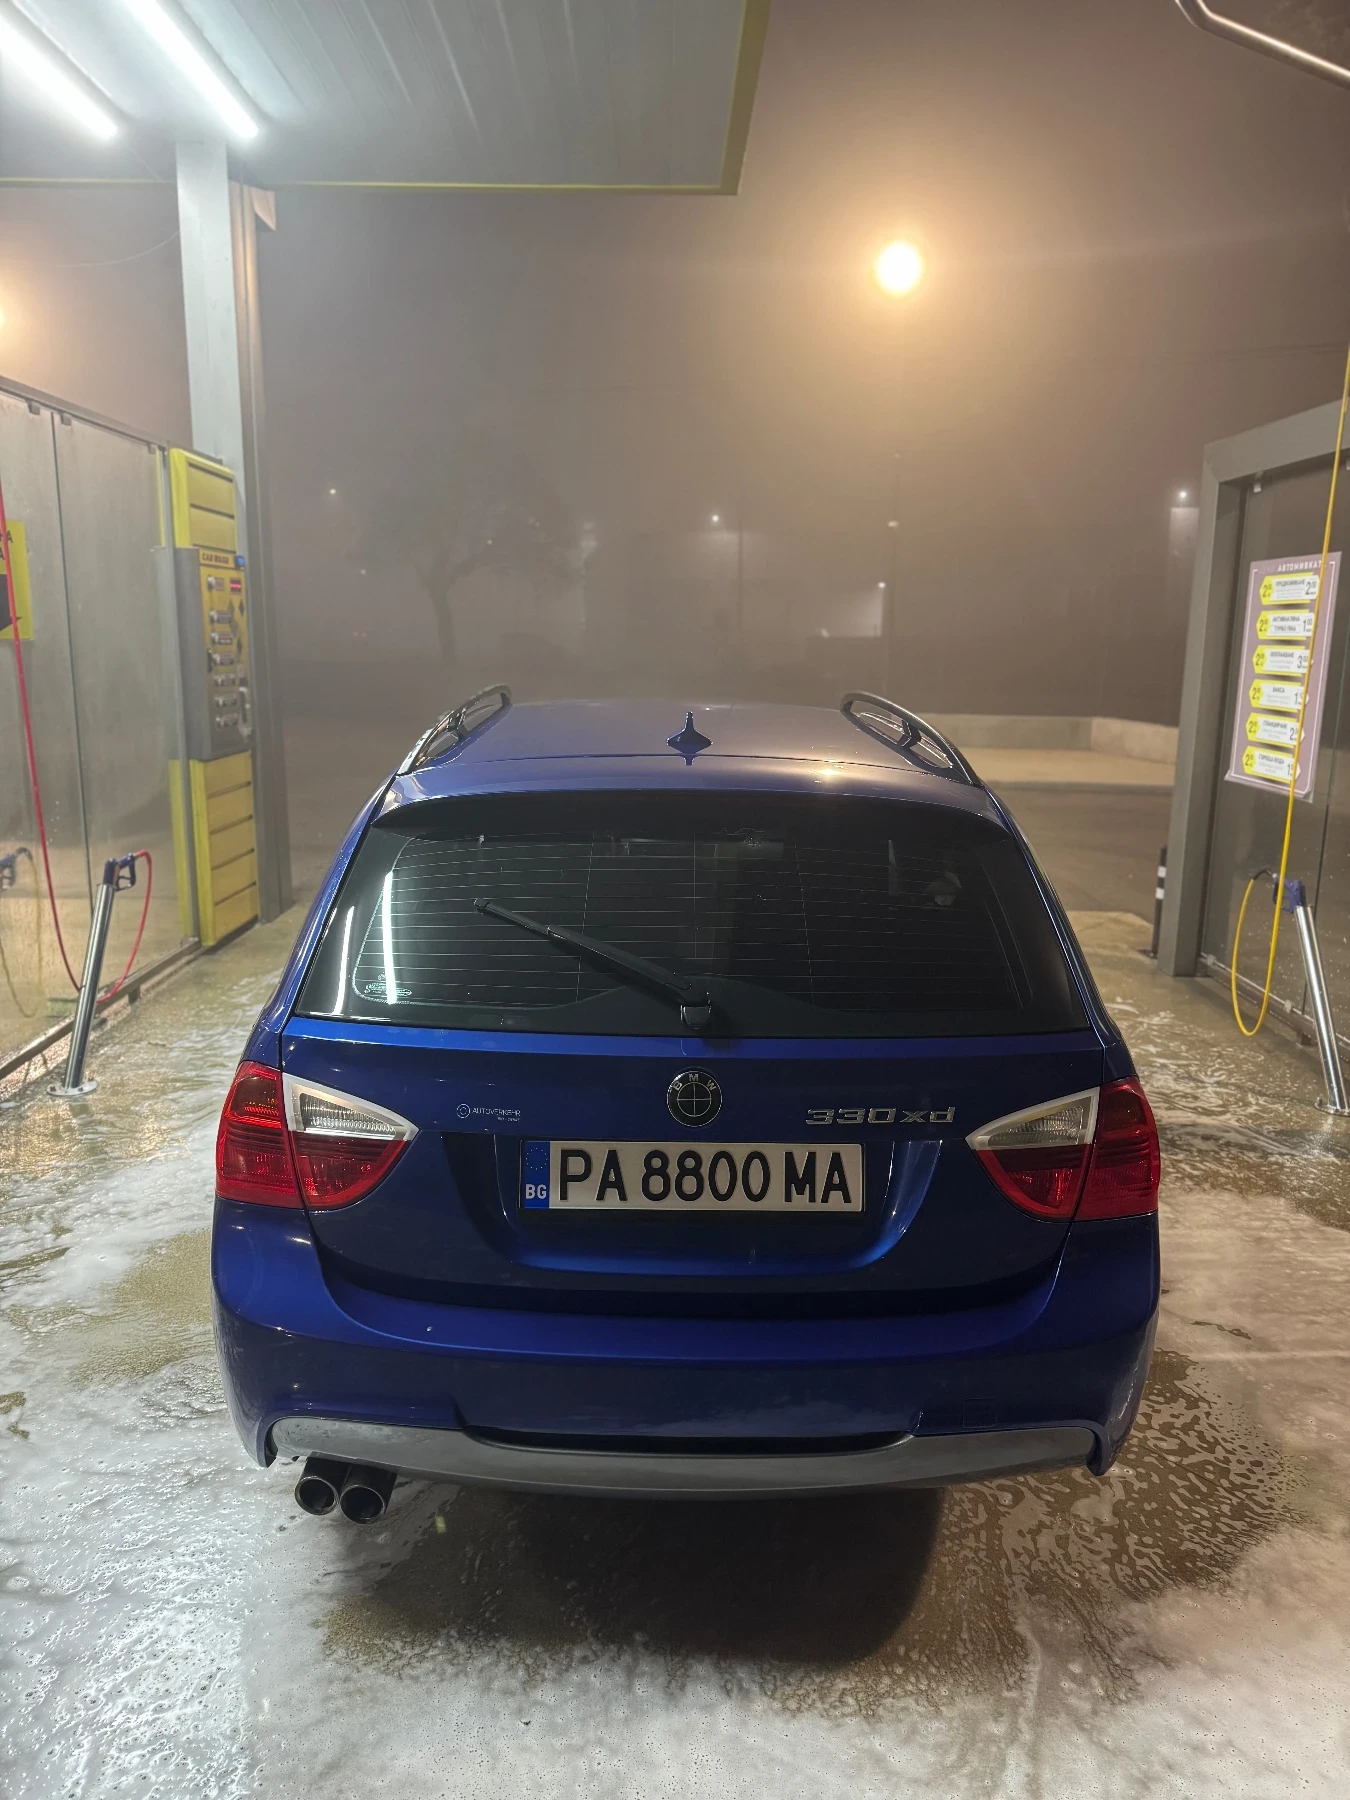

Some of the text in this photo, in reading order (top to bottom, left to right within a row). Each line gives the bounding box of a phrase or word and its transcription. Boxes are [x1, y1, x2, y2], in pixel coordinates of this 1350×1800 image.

[1277, 560, 1327, 572] АВТОМИВКАТ
[672, 1073, 717, 1091] BMW
[559, 1149, 852, 1204] PA 8800 MA
[525, 1184, 547, 1200] BG
